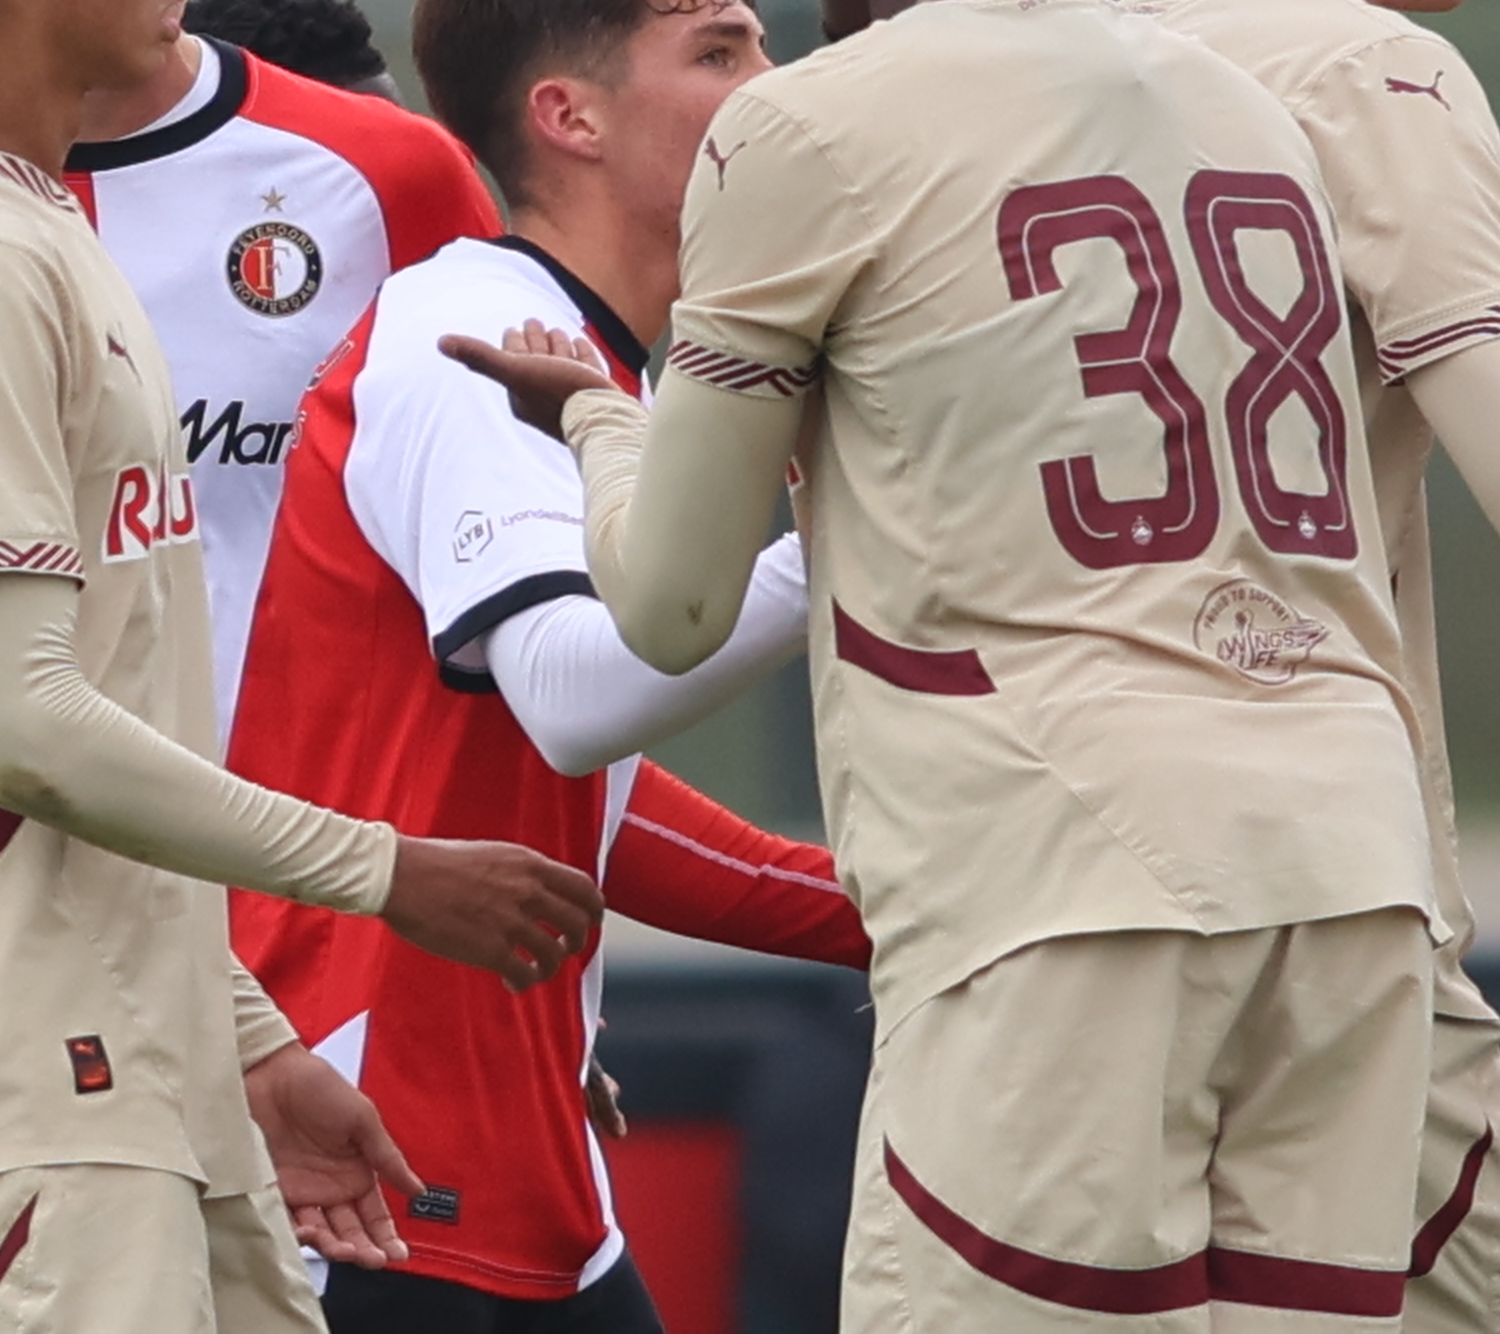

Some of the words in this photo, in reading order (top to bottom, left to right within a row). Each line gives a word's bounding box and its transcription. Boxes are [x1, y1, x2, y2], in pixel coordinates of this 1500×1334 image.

[996, 168, 1360, 573] 38
[179, 398, 296, 465] Mar
[457, 523, 485, 550] LYB
